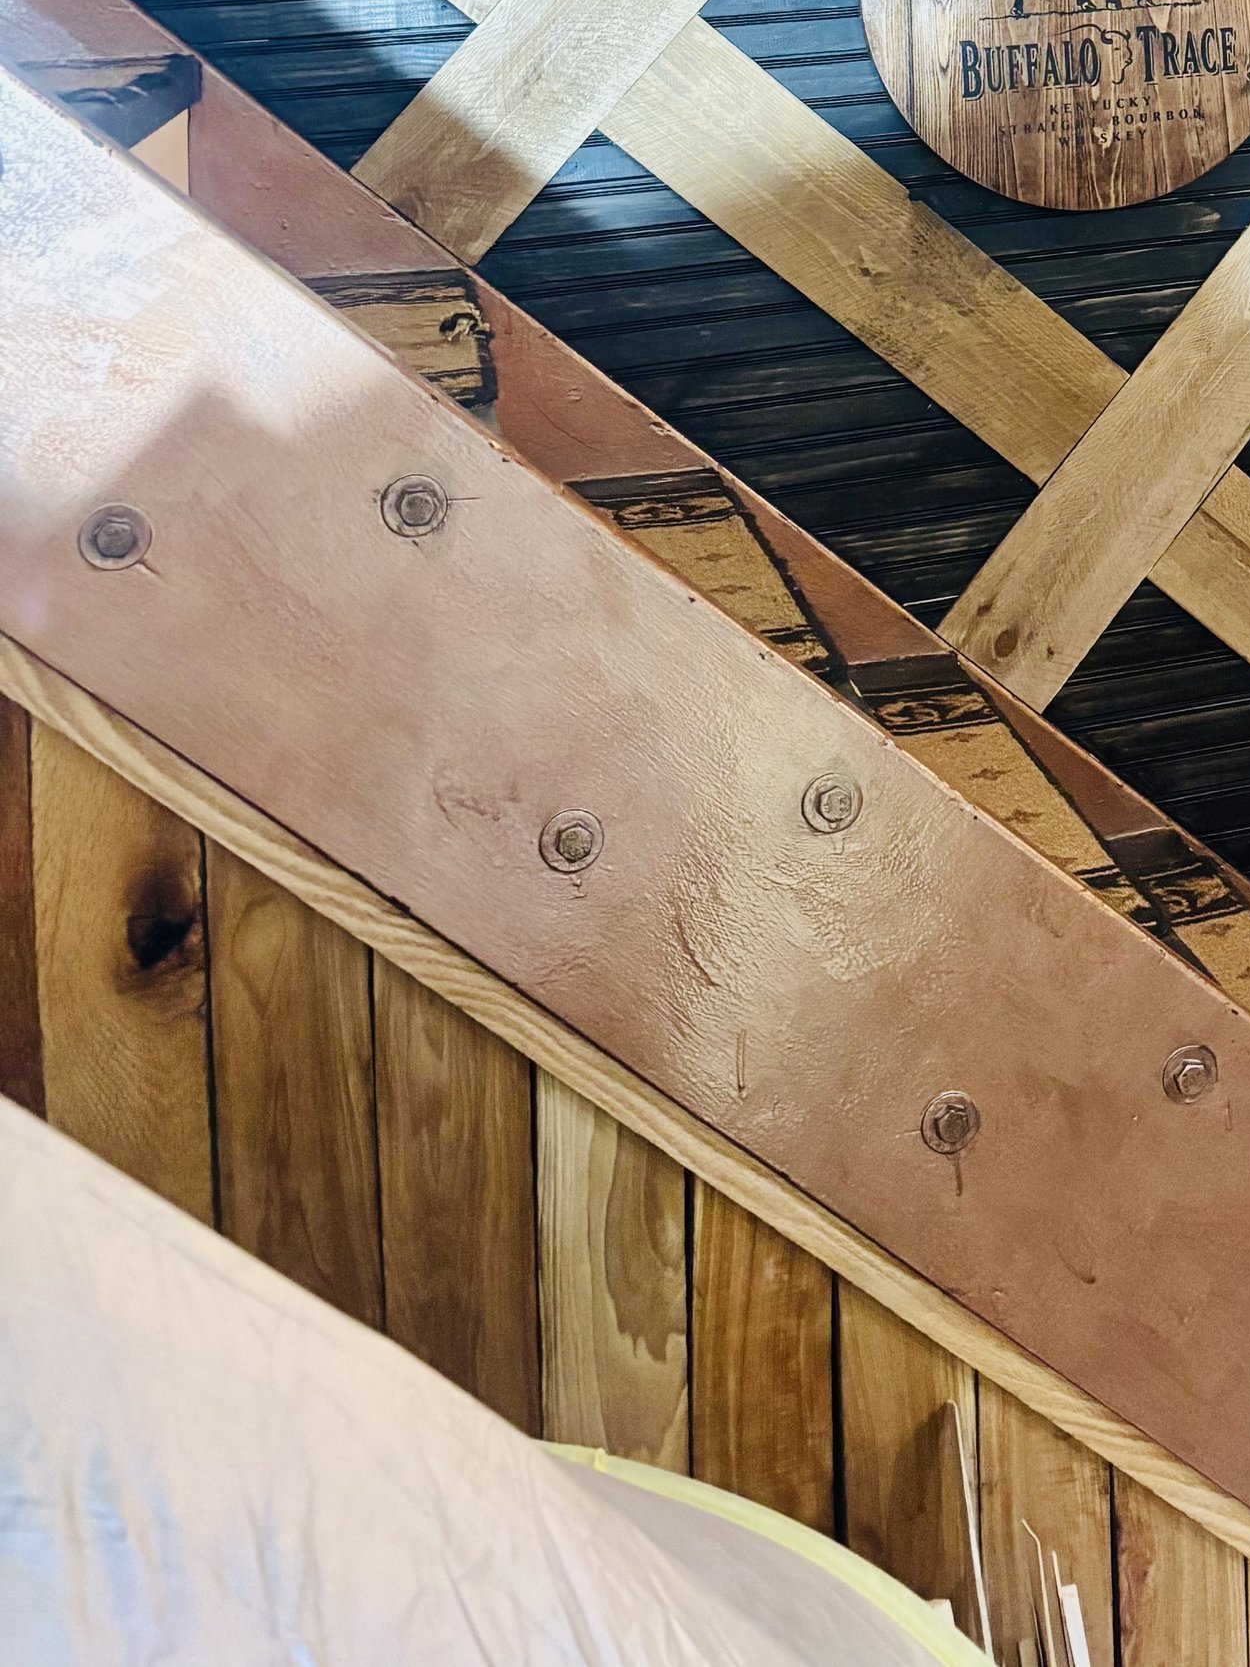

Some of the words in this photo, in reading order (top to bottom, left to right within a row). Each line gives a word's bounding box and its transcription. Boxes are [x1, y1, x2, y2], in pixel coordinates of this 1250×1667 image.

[960, 38, 1099, 101] BUFFALO
[1137, 25, 1238, 85] TRACE
[1049, 94, 1153, 117] KENTUCKY
[1111, 106, 1206, 126] BOURBON
